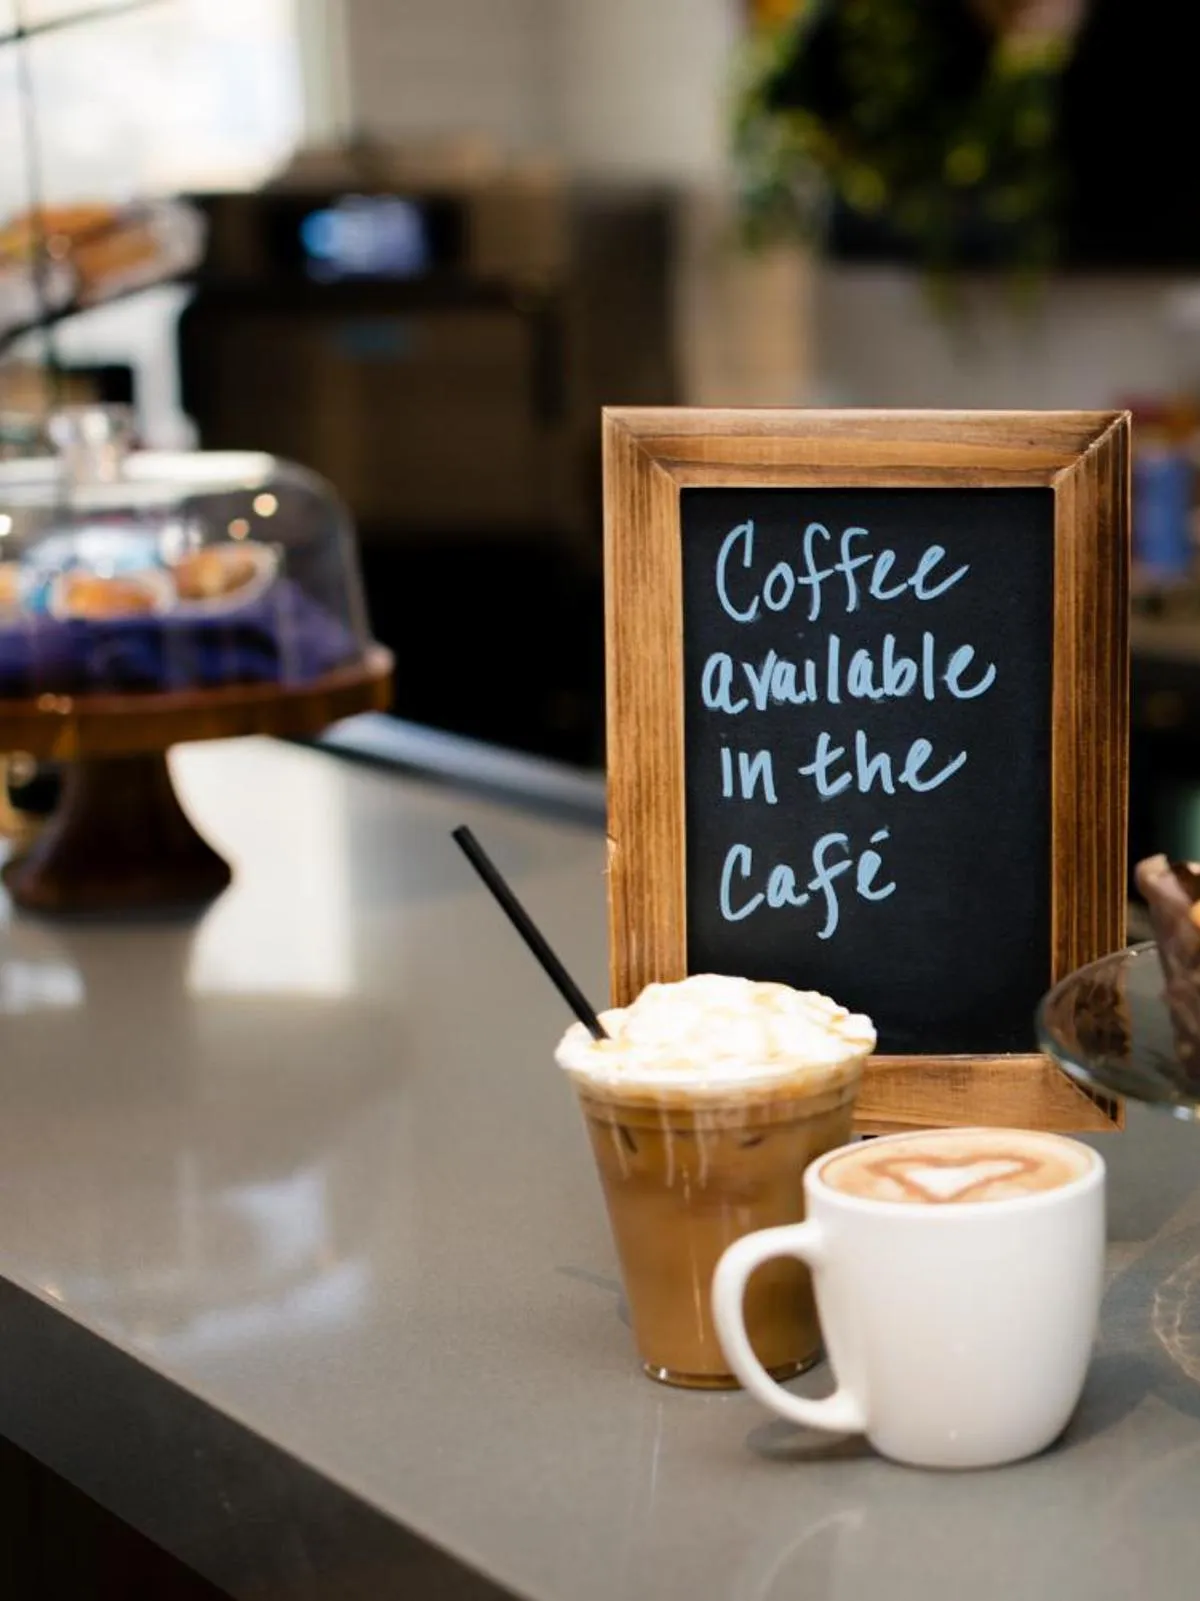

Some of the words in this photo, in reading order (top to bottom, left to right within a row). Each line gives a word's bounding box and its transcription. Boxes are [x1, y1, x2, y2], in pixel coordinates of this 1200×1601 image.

[715, 519, 970, 623] Coffee
[701, 631, 998, 715] available
[720, 746, 779, 806] in
[798, 729, 968, 798] the
[718, 828, 898, 940] Café
